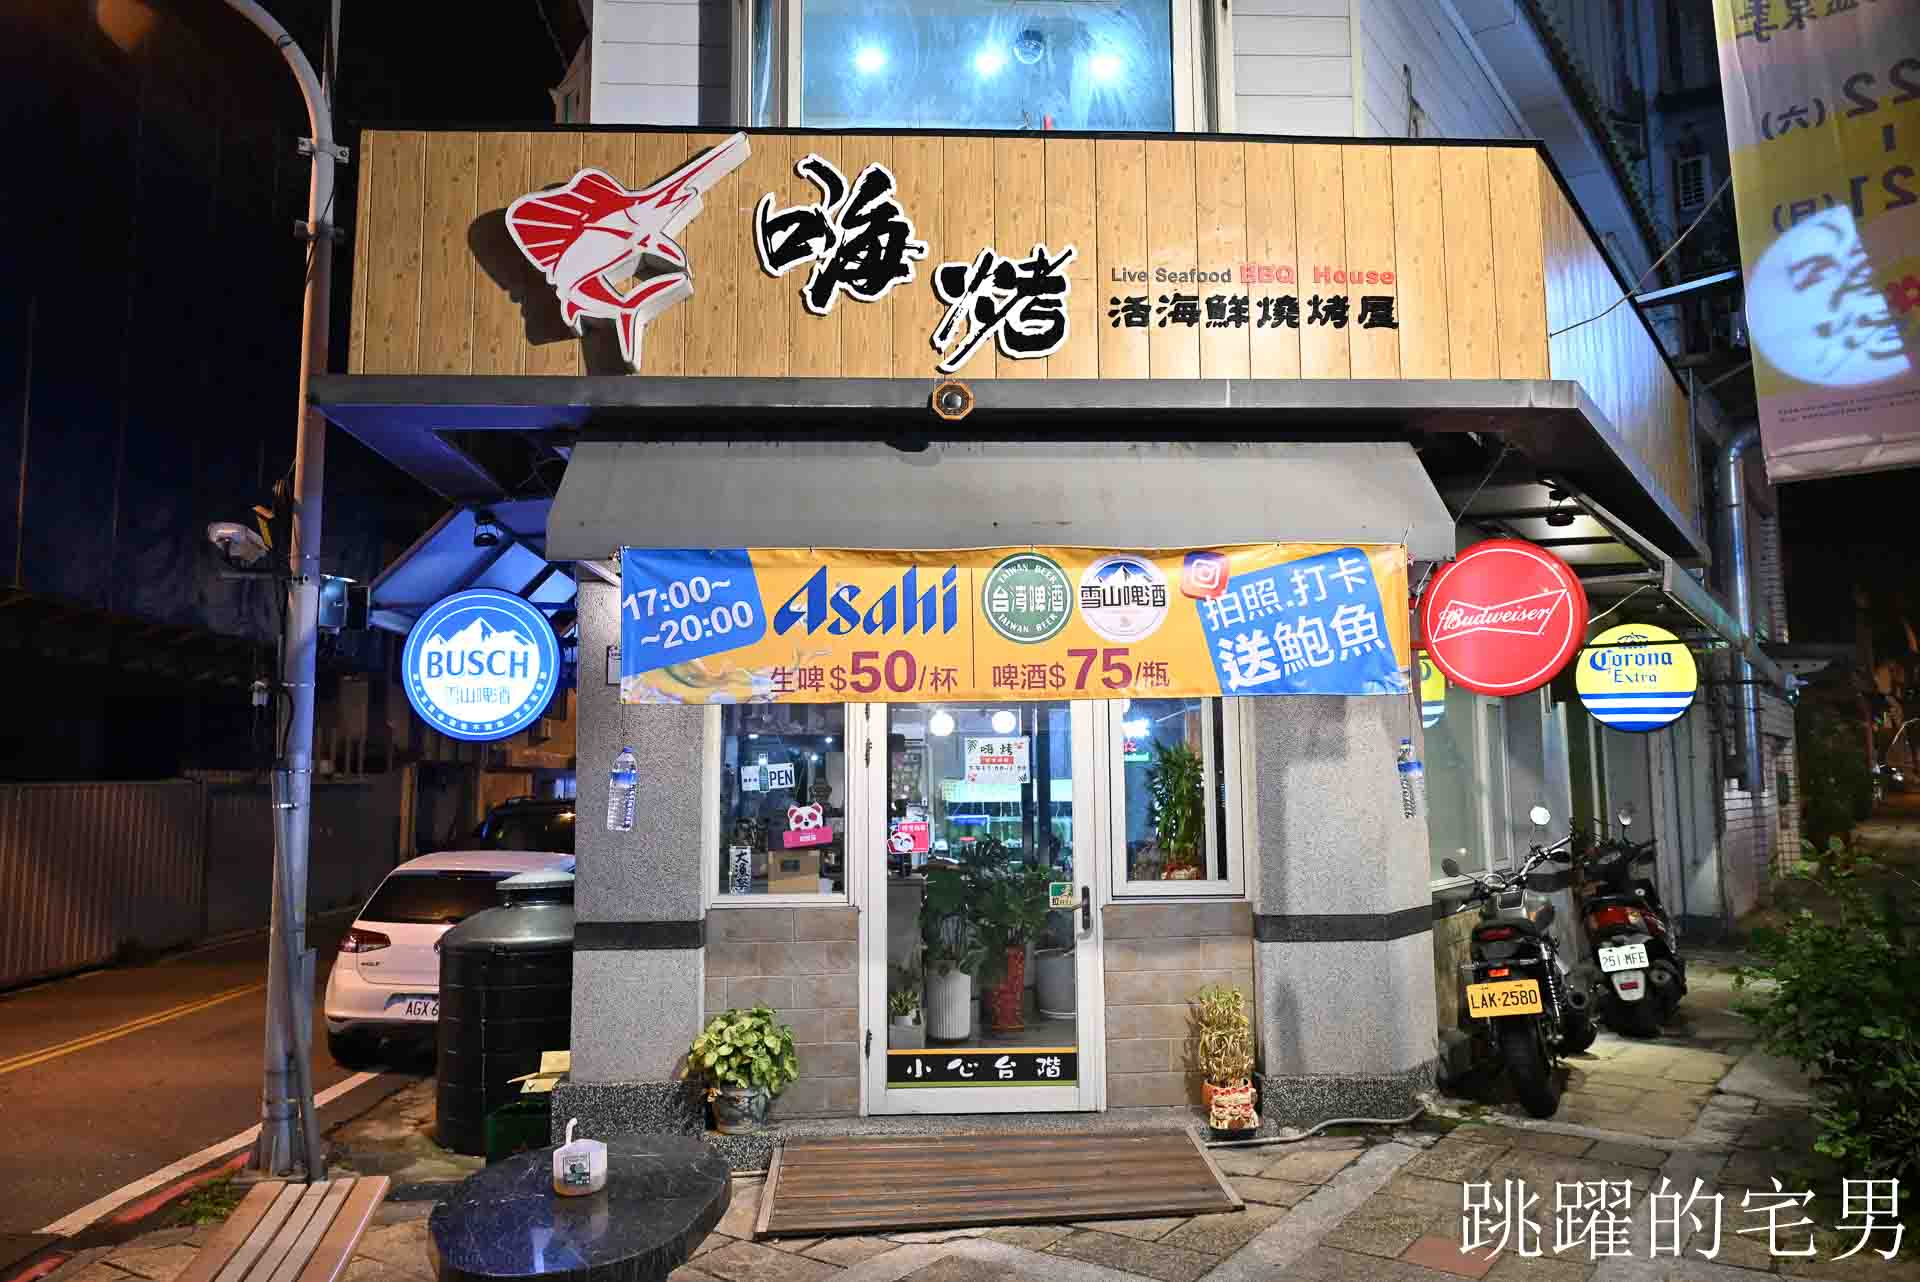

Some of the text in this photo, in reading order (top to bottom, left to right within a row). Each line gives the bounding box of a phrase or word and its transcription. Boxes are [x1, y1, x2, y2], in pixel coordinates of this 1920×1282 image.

[758, 155, 1075, 372] 嗨烤
[1111, 265, 1396, 285] Live Seafood BBQ House
[1108, 293, 1400, 329] 活海鮮燒烤屋
[622, 576, 731, 621] 17:00~
[773, 564, 957, 635] Asahi
[1081, 584, 1166, 609] 雪山啤酒
[641, 600, 753, 649] ~20:00
[1440, 606, 1551, 631] Budweiser
[1219, 602, 1386, 693] 送鮑魚
[426, 650, 529, 678] BUSCH
[1589, 650, 1673, 674] Corona
[1614, 669, 1657, 683] Extra
[1469, 989, 1539, 1009] LAK-2580
[906, 1055, 1061, 1079] 小心台階
